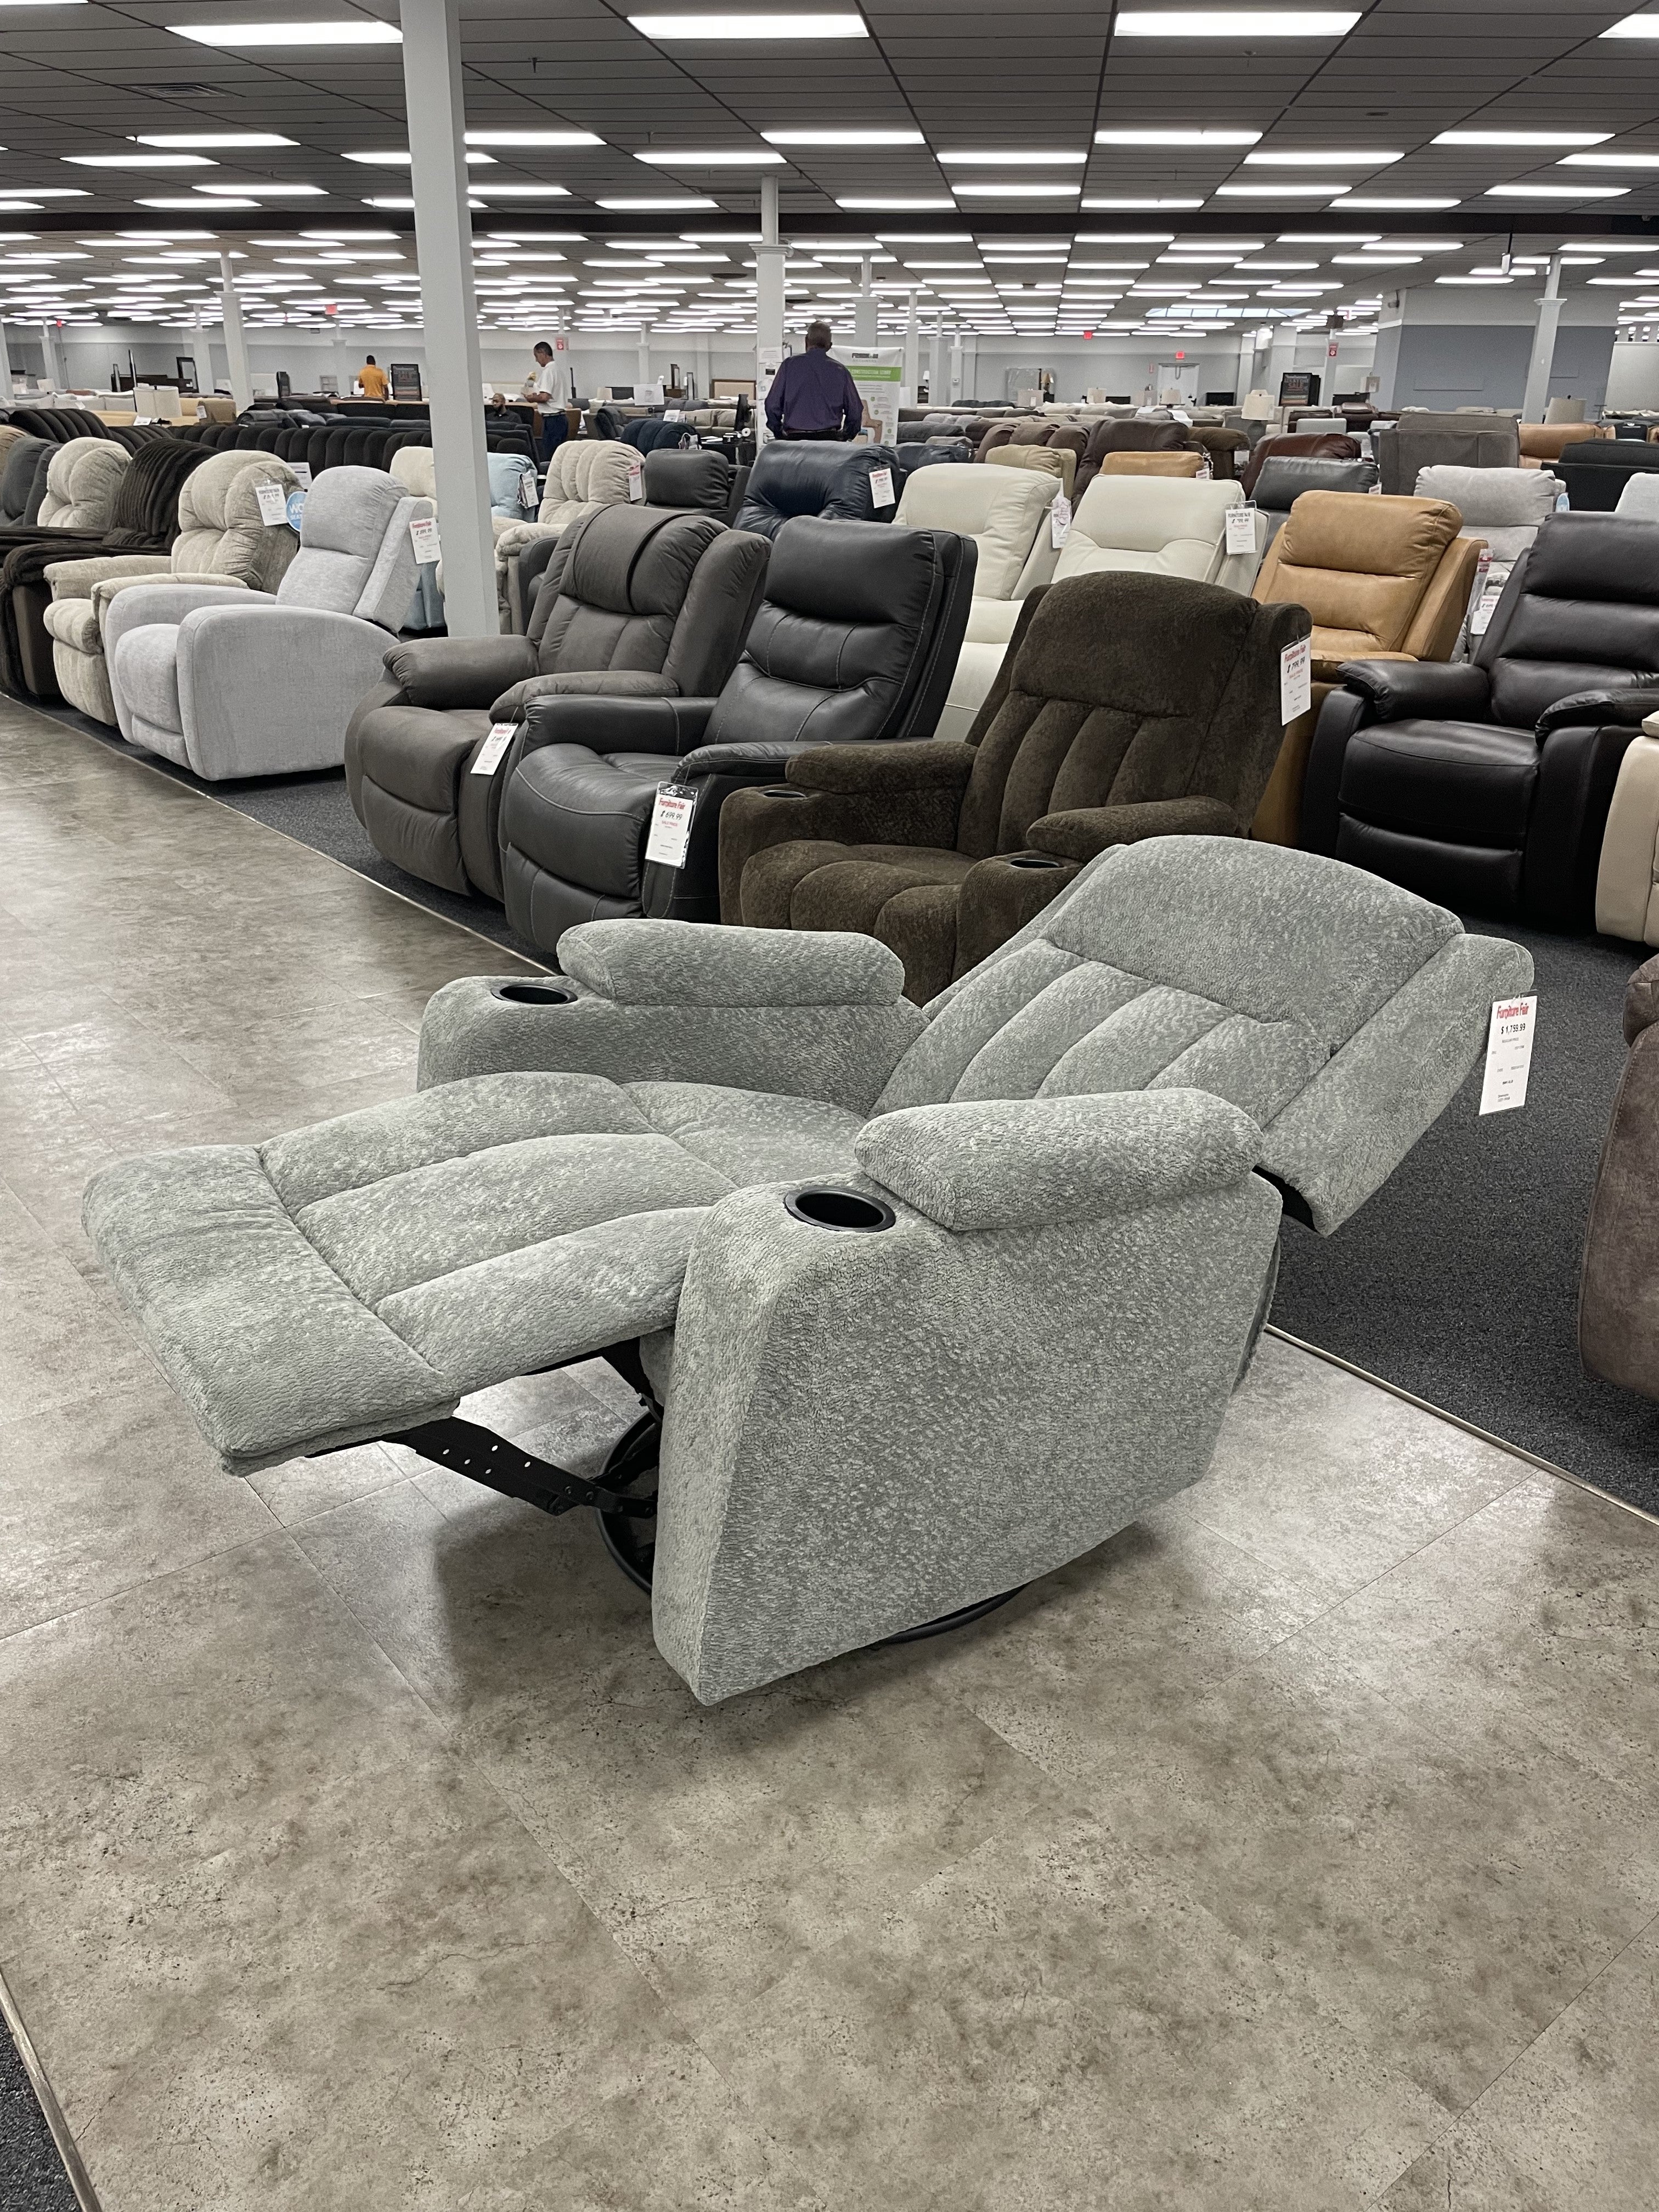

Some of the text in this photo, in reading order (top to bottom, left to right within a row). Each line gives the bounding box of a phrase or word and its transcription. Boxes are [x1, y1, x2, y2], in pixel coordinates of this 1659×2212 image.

[665, 811, 683, 821] 699.99
[1497, 1002, 1529, 1019] Furniture Fair
[1501, 1023, 1526, 1035] $ 1,759.99
